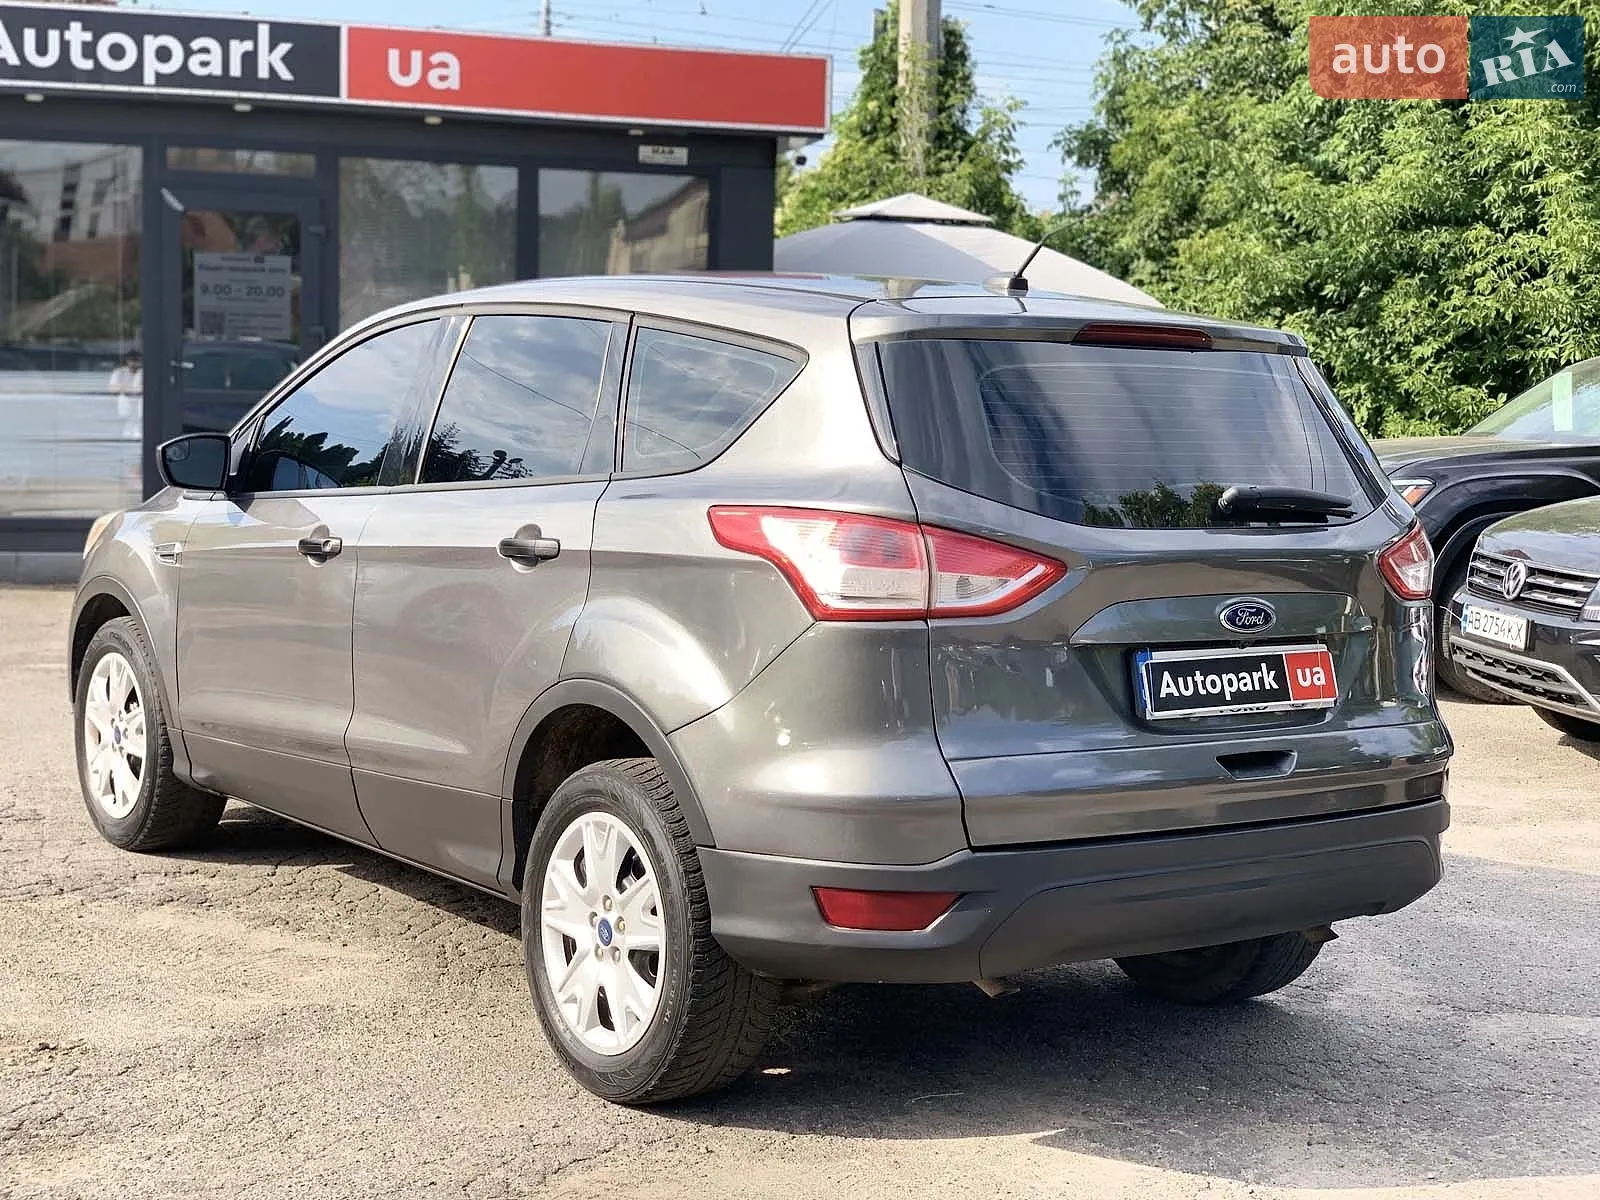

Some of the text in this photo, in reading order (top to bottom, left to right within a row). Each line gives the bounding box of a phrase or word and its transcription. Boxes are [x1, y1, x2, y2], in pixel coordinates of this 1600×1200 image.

[387, 47, 461, 91] ua
[1235, 607, 1266, 626] Ford
[1159, 662, 1327, 701] Autopark ua
